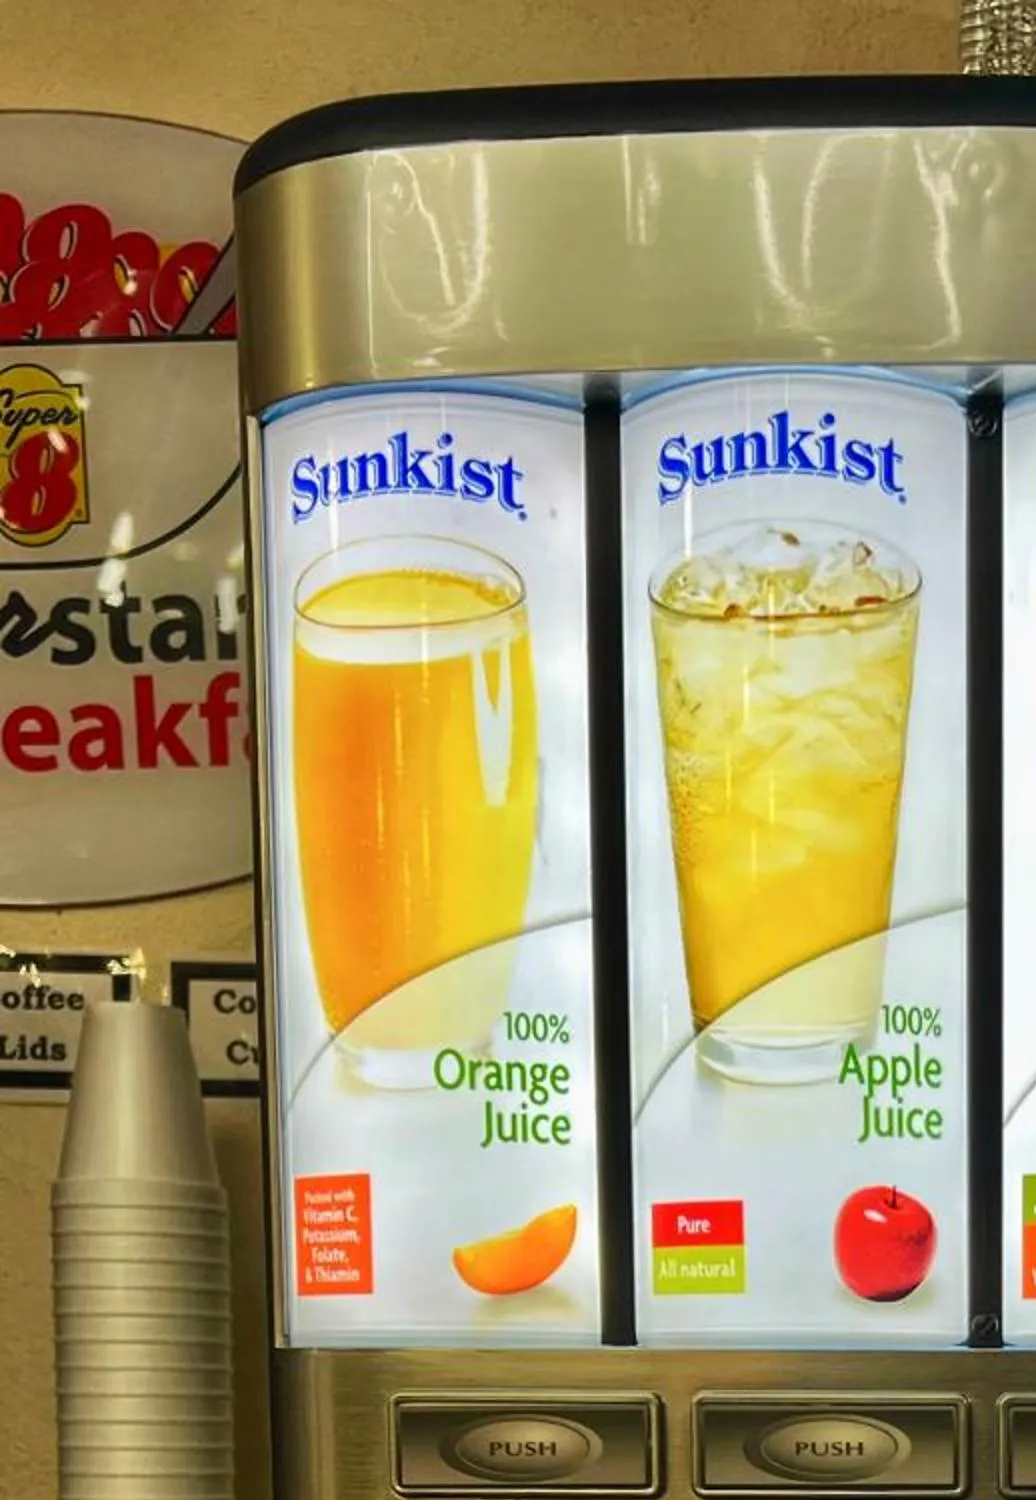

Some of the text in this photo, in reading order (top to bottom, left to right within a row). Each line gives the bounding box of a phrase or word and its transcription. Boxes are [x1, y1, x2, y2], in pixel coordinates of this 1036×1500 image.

[291, 431, 528, 526] Sunkist
[657, 410, 907, 504] Sunkist
[0, 430, 79, 534] 8
[1, 671, 258, 773] eakf
[503, 1011, 570, 1043] 100%
[881, 1004, 942, 1037] 100%
[0, 1034, 67, 1062] Lids
[838, 1041, 943, 1097] Apple
[433, 1048, 570, 1105] Orange
[480, 1101, 571, 1148] Juice
[857, 1096, 943, 1143] Juice
[676, 1215, 712, 1235] Pure
[658, 1255, 736, 1280] All natural
[488, 1440, 557, 1458] PUSH
[795, 1439, 865, 1458] PUSH
